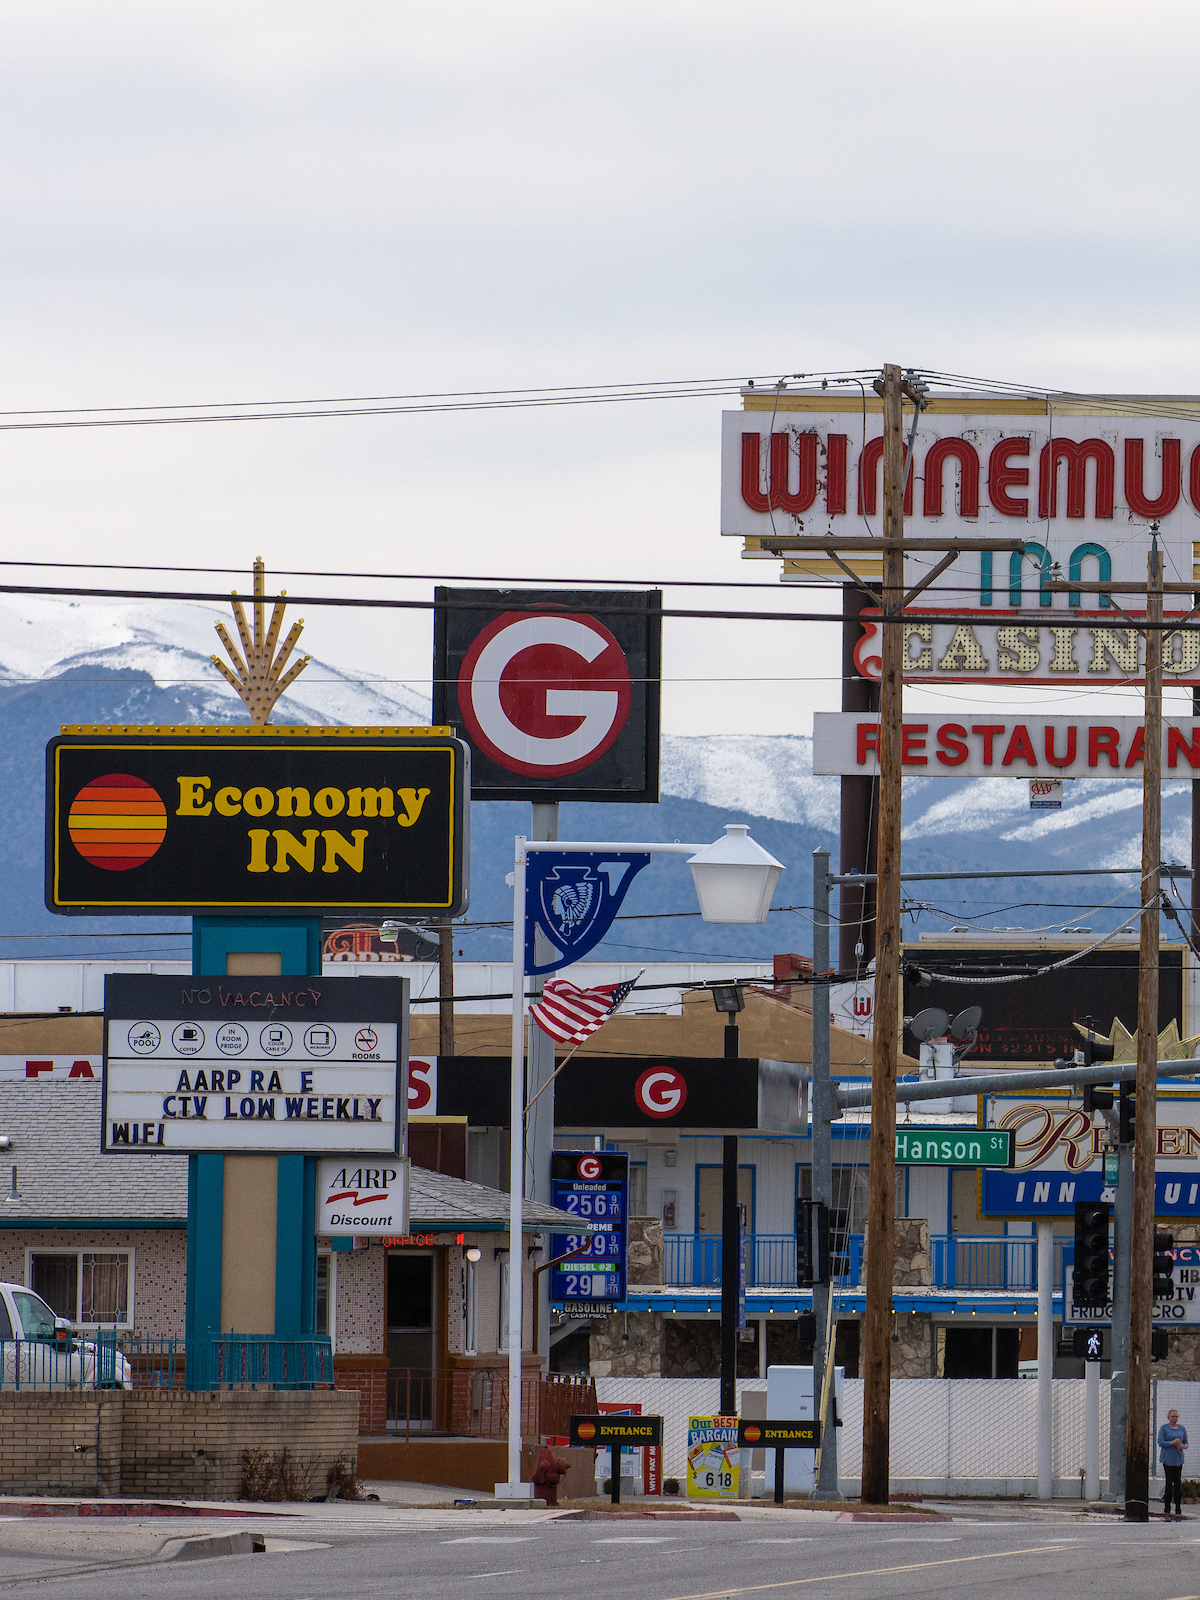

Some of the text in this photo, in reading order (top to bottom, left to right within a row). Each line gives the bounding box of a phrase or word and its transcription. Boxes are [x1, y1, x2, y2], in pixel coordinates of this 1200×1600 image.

[980, 541, 1112, 607] INN
[471, 617, 619, 766] G
[176, 776, 430, 827] Economy
[247, 829, 369, 873] INN
[182, 986, 322, 1006] NO VACANCY
[133, 1039, 156, 1047] POOL
[177, 1069, 241, 1092] AARP
[641, 1072, 681, 1113] G
[162, 1096, 382, 1121] CTV LOW WEEKLY
[112, 1122, 165, 1144] WIFI
[895, 1134, 1003, 1160] Hanson St
[329, 1168, 397, 1188] AARP
[580, 1158, 599, 1178] G
[573, 1183, 607, 1191] Unleaded
[1015, 1181, 1076, 1203] INN
[566, 1194, 607, 1215] 256
[330, 1214, 393, 1226] Discount
[382, 1233, 434, 1247] OFFICE
[564, 1263, 612, 1272] DIESEL #2
[564, 1303, 612, 1313] GASOLINE
[600, 1426, 653, 1436] ENTRANCE
[692, 1417, 739, 1429] Our BEST
[691, 1429, 738, 1444] BARGAIN
[764, 1430, 813, 1439] ENTRANCE
[706, 1472, 714, 1487] 6
[718, 1472, 732, 1487] 18
